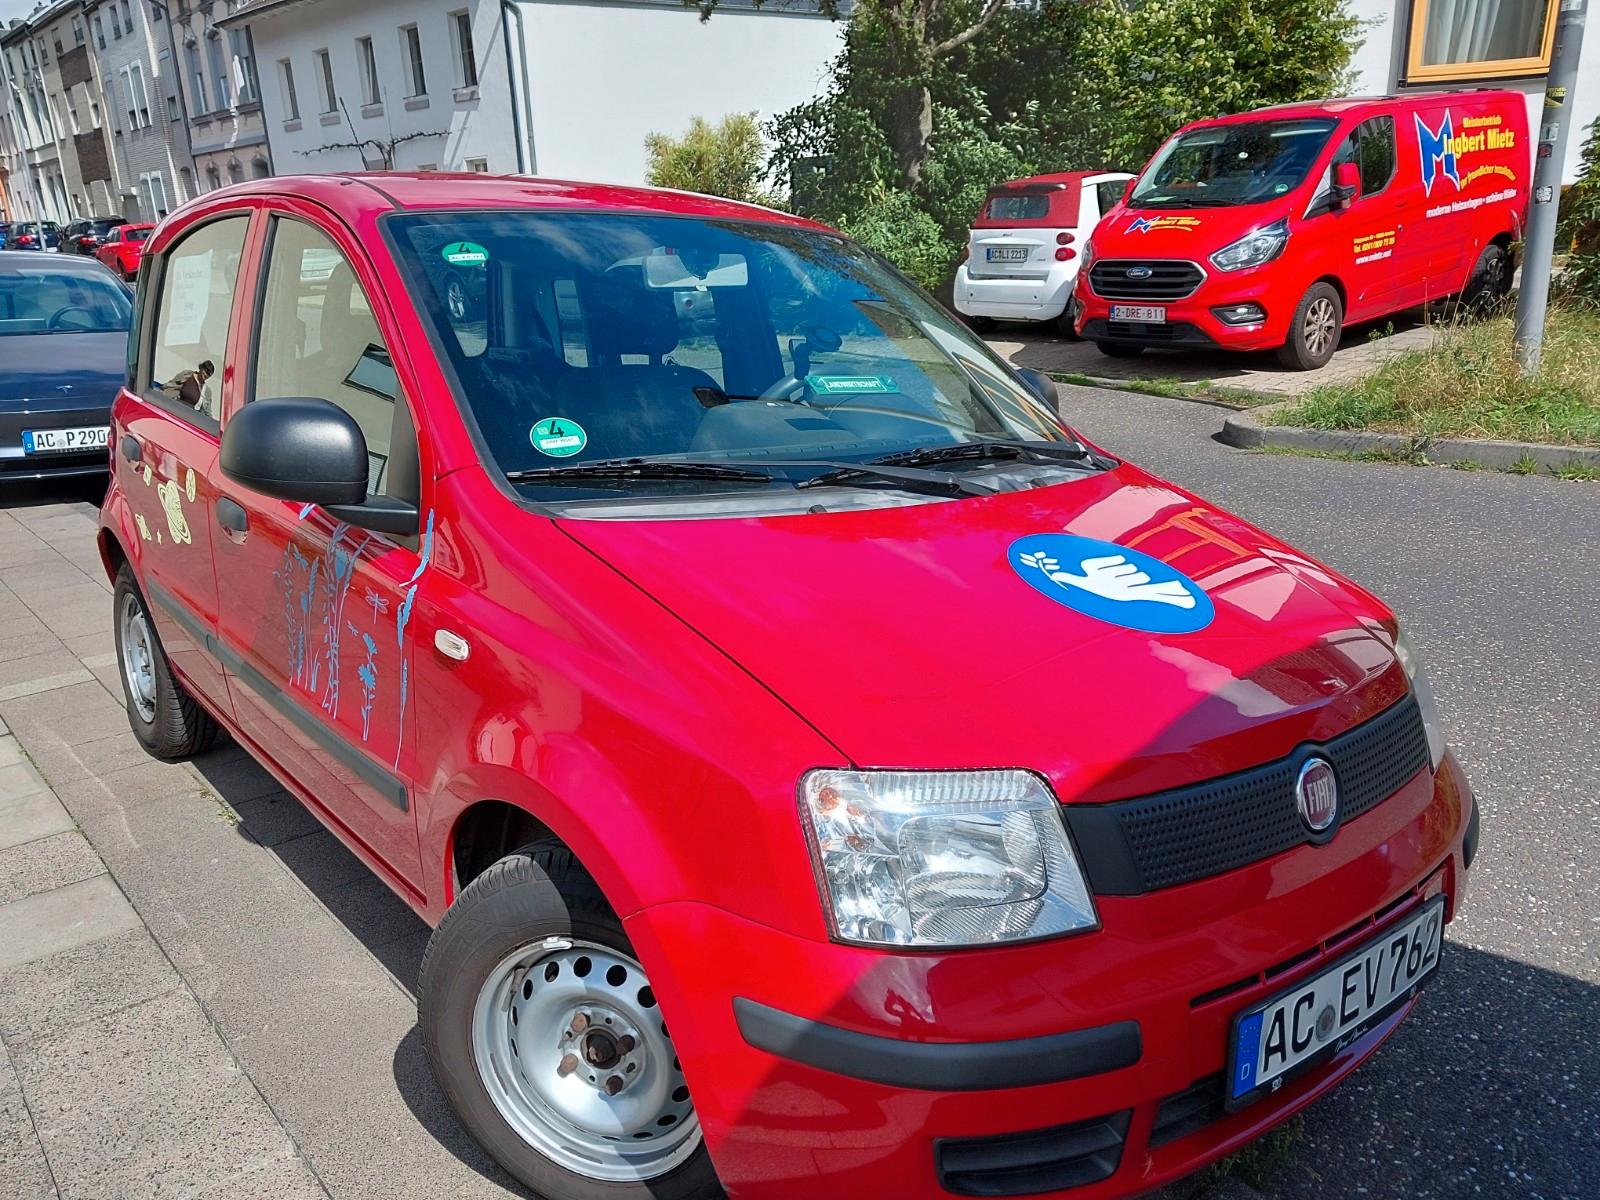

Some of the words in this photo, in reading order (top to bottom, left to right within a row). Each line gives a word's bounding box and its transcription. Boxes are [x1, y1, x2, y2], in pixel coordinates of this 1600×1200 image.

[1443, 130, 1485, 159] Ingbert
[1487, 128, 1515, 149] Mietz
[459, 243, 470, 254] 4
[1010, 250, 1026, 259] 2213
[1116, 307, 1164, 318] 2-DRE-811
[549, 420, 565, 437] 4
[37, 432, 56, 449] AC
[65, 431, 75, 446] P
[1306, 776, 1329, 815] FIAT
[1241, 1063, 1251, 1080] D
[1263, 990, 1315, 1073] AC
[1339, 949, 1384, 1028] EV
[1389, 911, 1439, 993] 762
